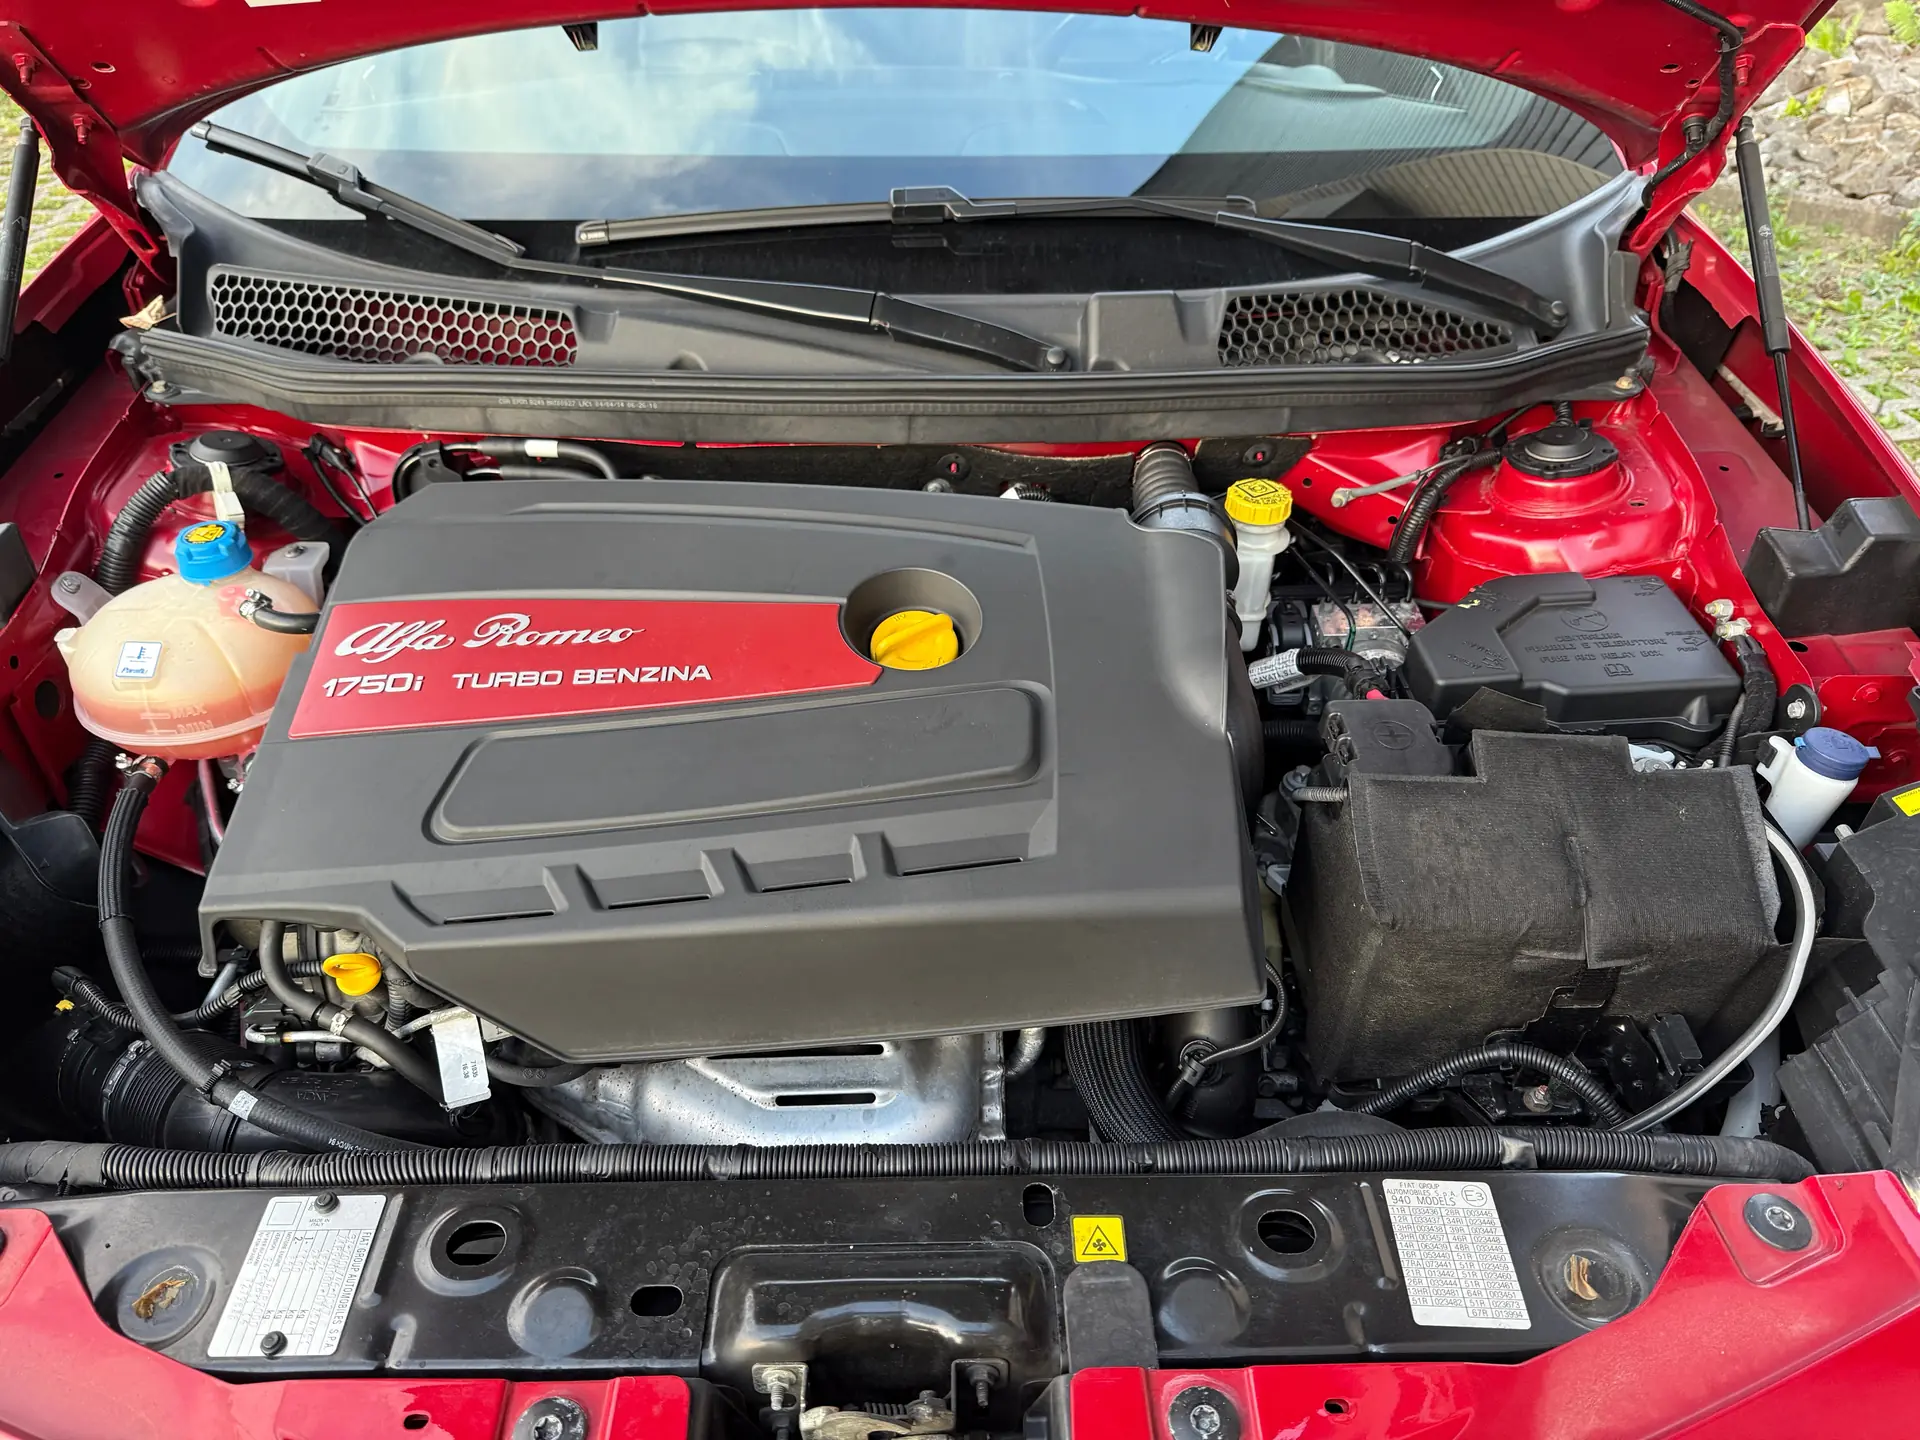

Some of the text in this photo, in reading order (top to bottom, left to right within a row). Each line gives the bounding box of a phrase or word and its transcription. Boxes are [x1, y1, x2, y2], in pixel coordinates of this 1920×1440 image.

[335, 613, 645, 664] Alfa Romeo
[321, 666, 712, 697] 1750i TURBO BENZINA
[171, 703, 207, 720] MAX
[176, 720, 214, 734] MIN
[1392, 1195, 1456, 1206] 940 MODELS
[1463, 1190, 1484, 1202] E3
[361, 1231, 372, 1246] FIAT
[351, 1247, 366, 1272] GROUP
[332, 1274, 357, 1325] AUTOMOBILES
